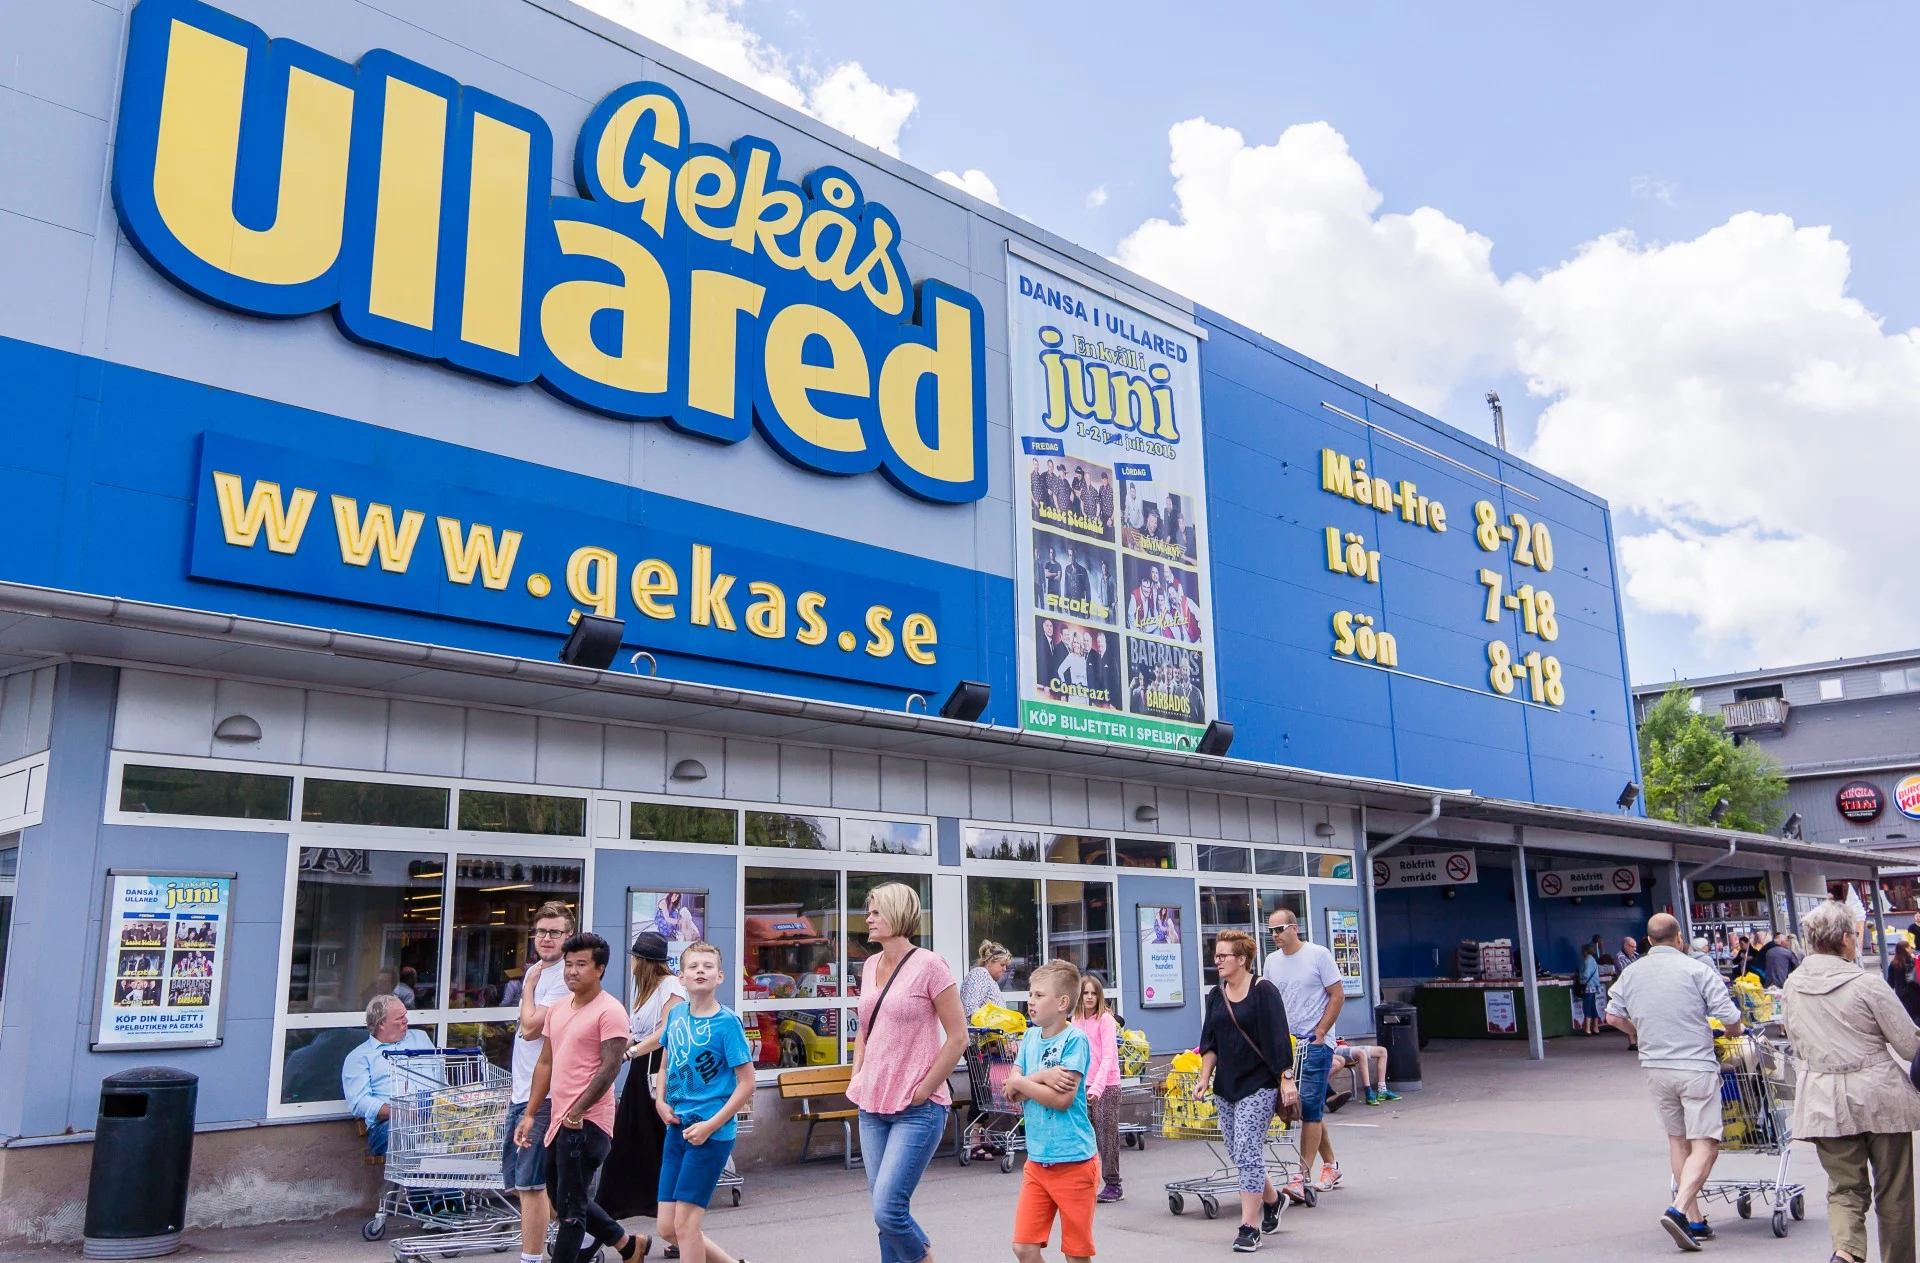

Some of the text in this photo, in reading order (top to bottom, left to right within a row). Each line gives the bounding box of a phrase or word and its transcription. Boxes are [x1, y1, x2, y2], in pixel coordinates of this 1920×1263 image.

[596, 94, 905, 316] Gekås
[153, 17, 978, 484] Ullared
[1019, 275, 1188, 363] DANSA I ULLARED
[1039, 326, 1180, 444] juni
[1031, 441, 1059, 452] FREDAG
[1125, 433, 1144, 452] juli
[1146, 441, 1176, 460] 2016
[1121, 466, 1147, 477] LÖRDAG
[1321, 448, 1554, 572] Mån-Fre 8-20
[213, 470, 938, 666] www.gekas.se
[1325, 526, 1559, 642] Lör 7-18
[1332, 610, 1565, 706] Sön 8-18
[1050, 677, 1110, 702] Contrazt
[1146, 689, 1191, 715] BARBADOS
[1029, 708, 1057, 727] KÖP
[1060, 714, 1127, 738] BILJETTER
[1130, 726, 1134, 738] I
[1841, 799, 1877, 810] THAI
[1399, 858, 1436, 870] Rökfritt
[1570, 871, 1603, 882] Rökfritt
[1400, 872, 1437, 883] område
[1571, 883, 1605, 893] område
[1718, 884, 1755, 893] Rökzon
[165, 881, 220, 909] juni
[115, 1023, 167, 1031] SPELBUTIKEN
[116, 1014, 137, 1023] KÖP
[160, 1014, 196, 1022] BILJETT
